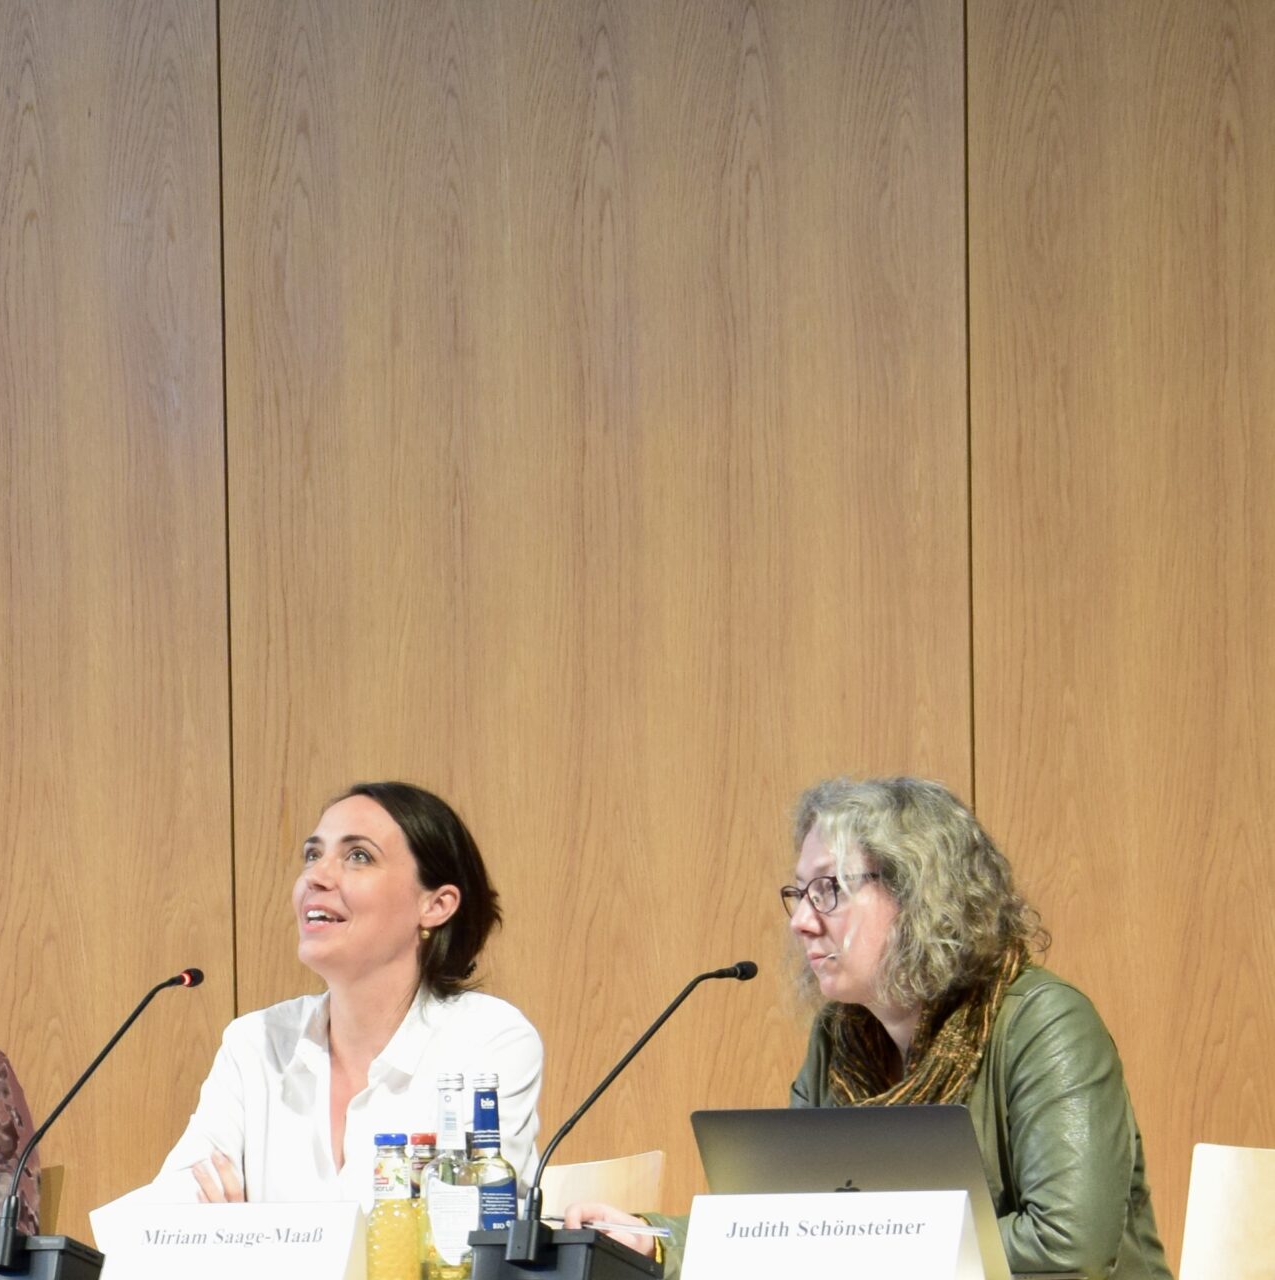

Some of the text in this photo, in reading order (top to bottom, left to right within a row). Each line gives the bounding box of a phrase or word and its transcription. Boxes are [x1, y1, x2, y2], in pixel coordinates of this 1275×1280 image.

[142, 1227, 324, 1247] Miriam Saage-Maaß
[726, 1218, 925, 1238] Judith Schönsteiner
